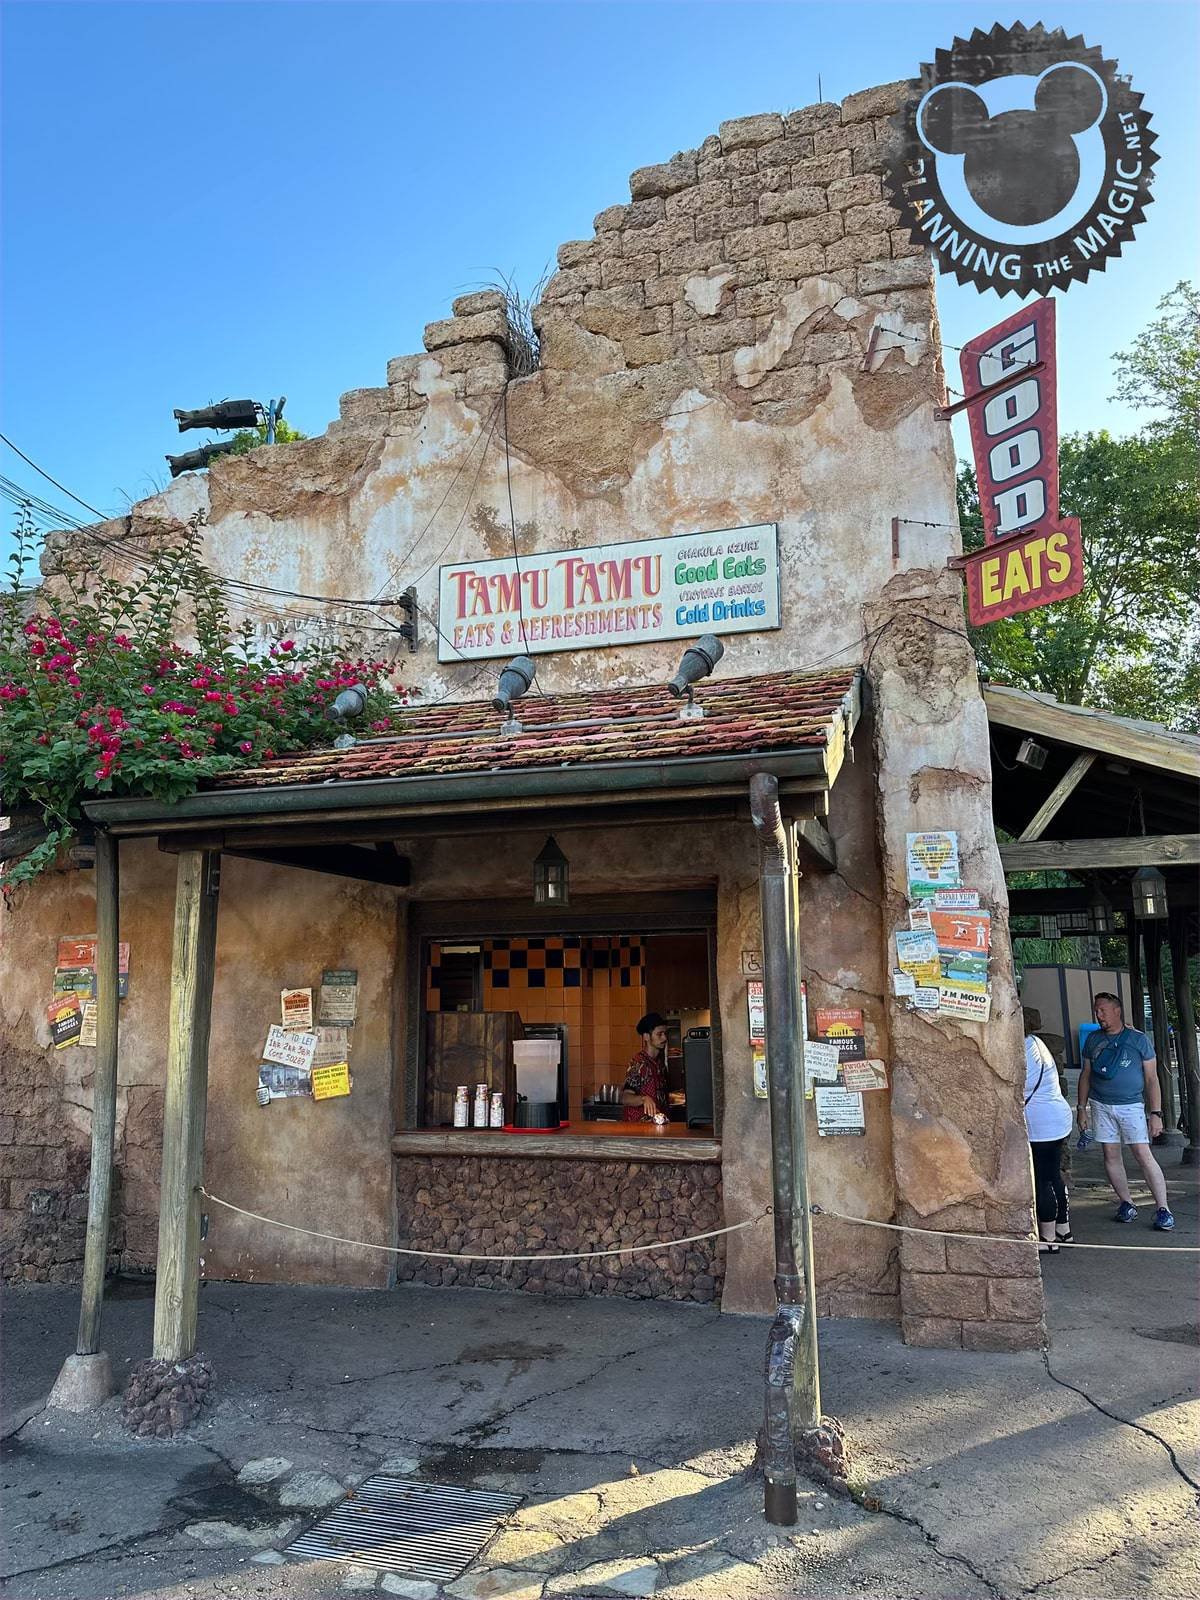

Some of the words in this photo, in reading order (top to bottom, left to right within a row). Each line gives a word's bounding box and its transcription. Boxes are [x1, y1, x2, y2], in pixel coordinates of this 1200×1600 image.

[977, 320, 1046, 537] GOOD
[678, 545, 723, 560] CHAKULA
[727, 540, 760, 554] NZURI
[675, 558, 718, 585] Good
[723, 555, 766, 579] Eats
[981, 532, 1072, 607] EATS
[449, 569, 549, 620] TAMU
[556, 555, 663, 609] TAMU
[452, 622, 495, 650] EATS
[501, 619, 513, 645] &
[517, 602, 664, 642] REFRESHMENTS
[676, 603, 709, 625] Cold
[713, 597, 766, 621] Drinks
[960, 992, 986, 1003] MOYO
[302, 1036, 314, 1045] LET
